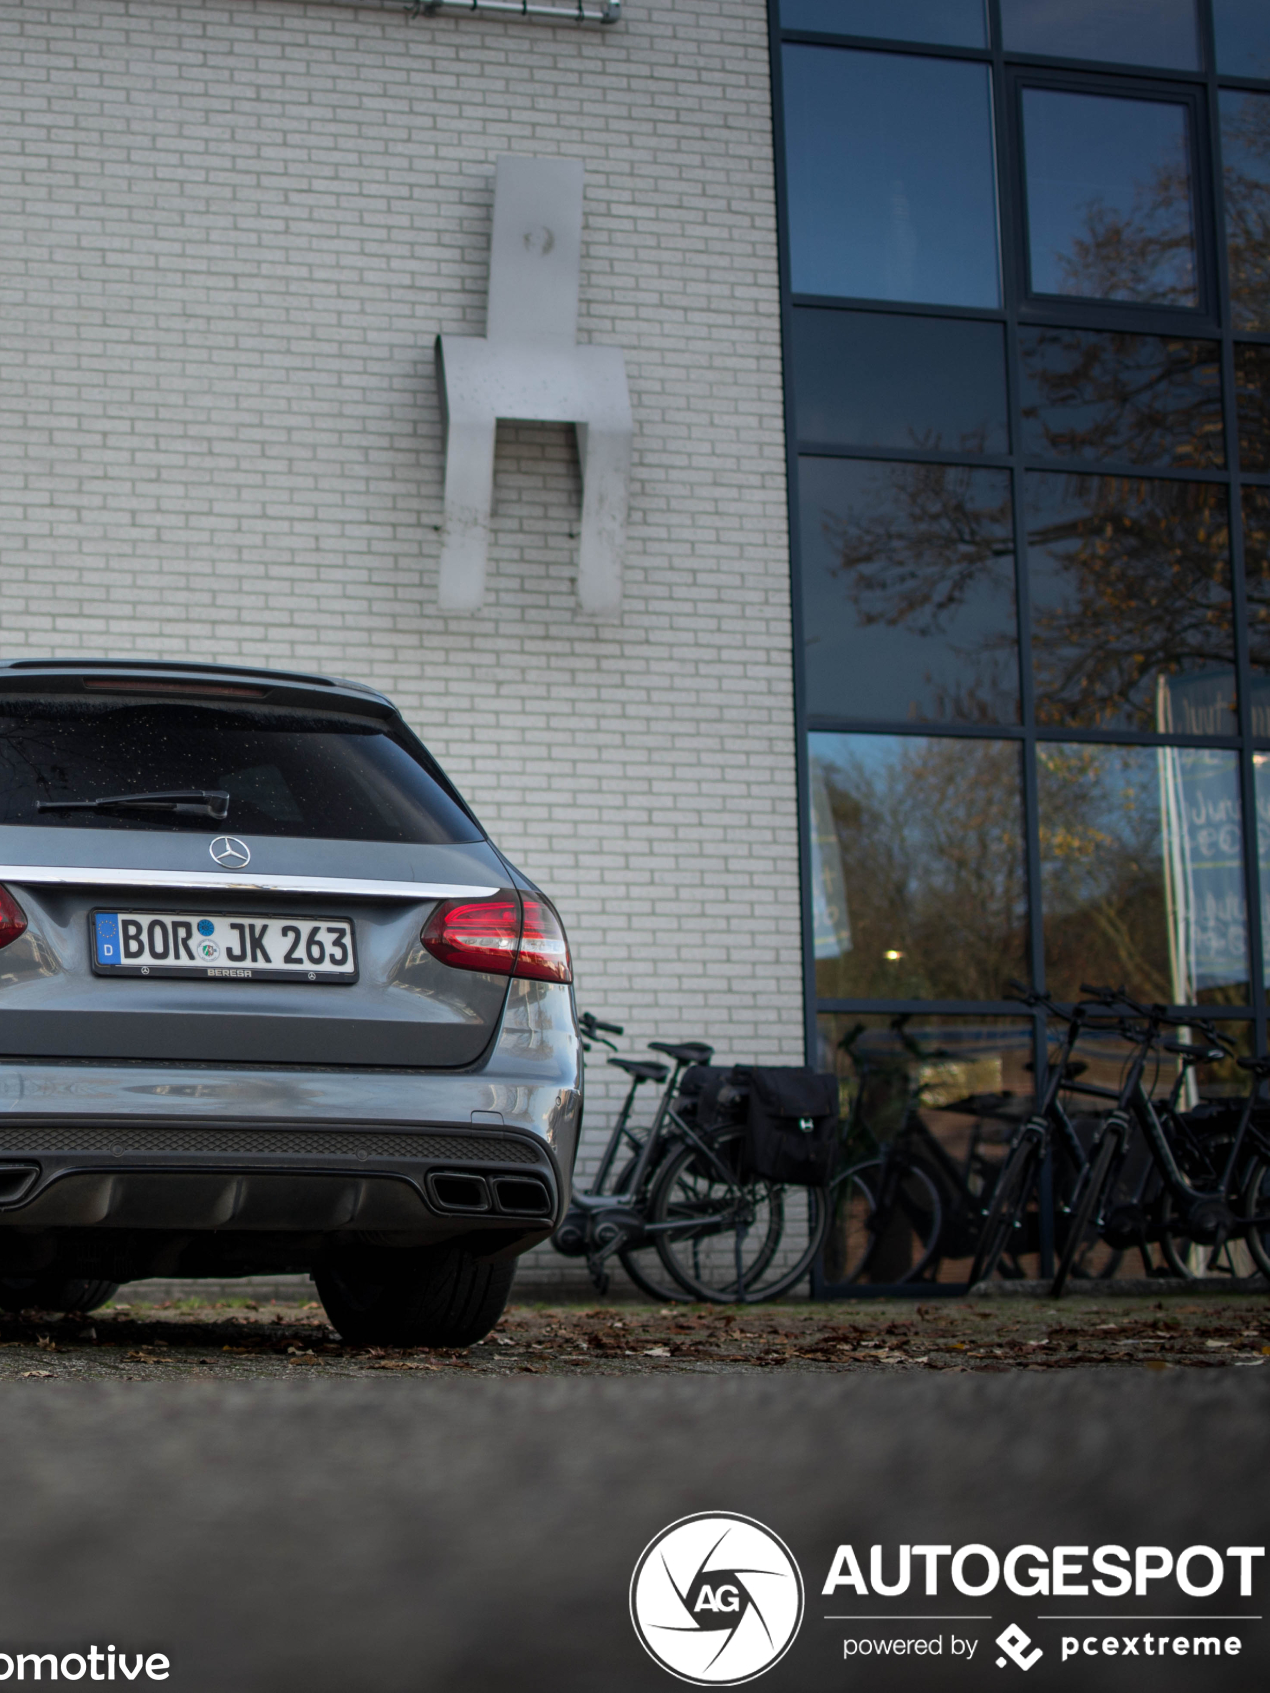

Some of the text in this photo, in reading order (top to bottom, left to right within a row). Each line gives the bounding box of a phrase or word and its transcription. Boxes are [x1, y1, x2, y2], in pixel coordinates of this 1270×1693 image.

[121, 919, 195, 961] BOR
[225, 923, 272, 963] JK
[281, 925, 348, 966] 263
[104, 944, 113, 956] D
[207, 969, 252, 978] BERESA
